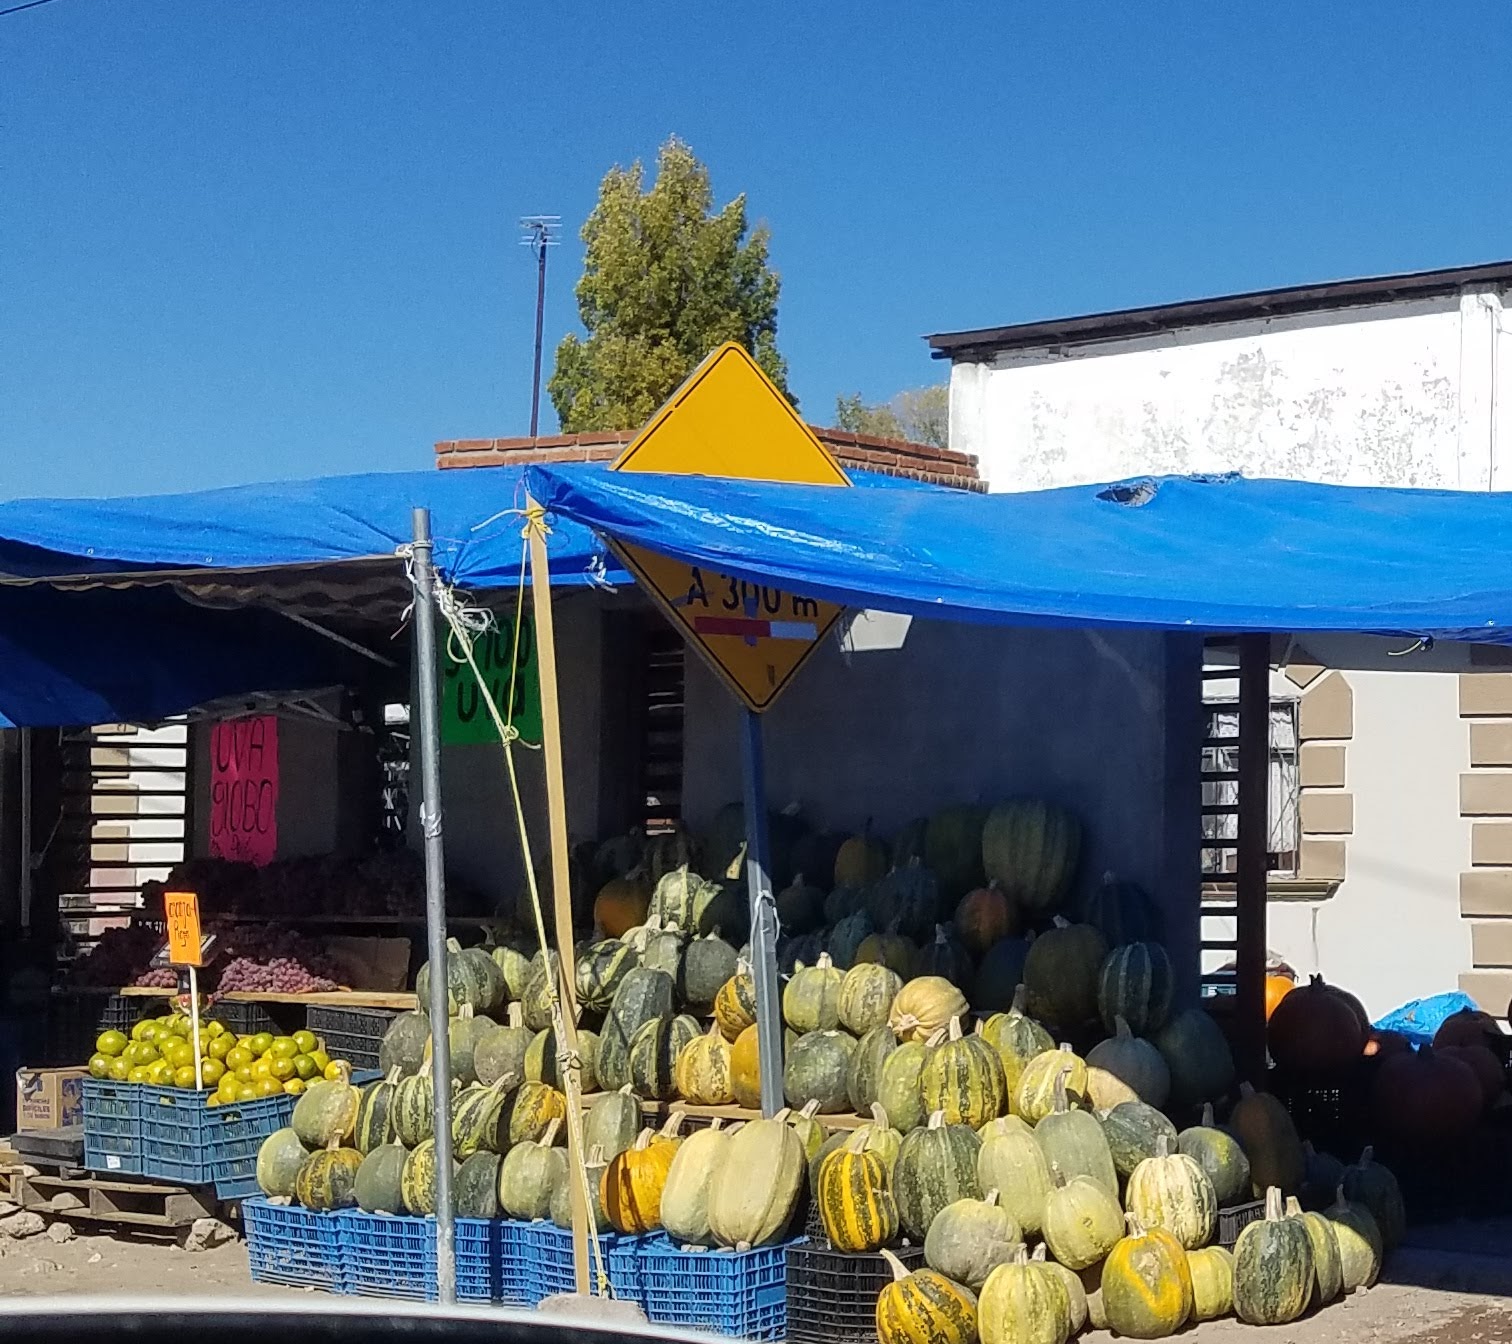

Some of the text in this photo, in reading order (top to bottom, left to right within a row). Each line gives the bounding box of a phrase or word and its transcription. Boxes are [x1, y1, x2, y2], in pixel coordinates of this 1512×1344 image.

[686, 566, 819, 618] A 300 m
[216, 718, 265, 773] UVA
